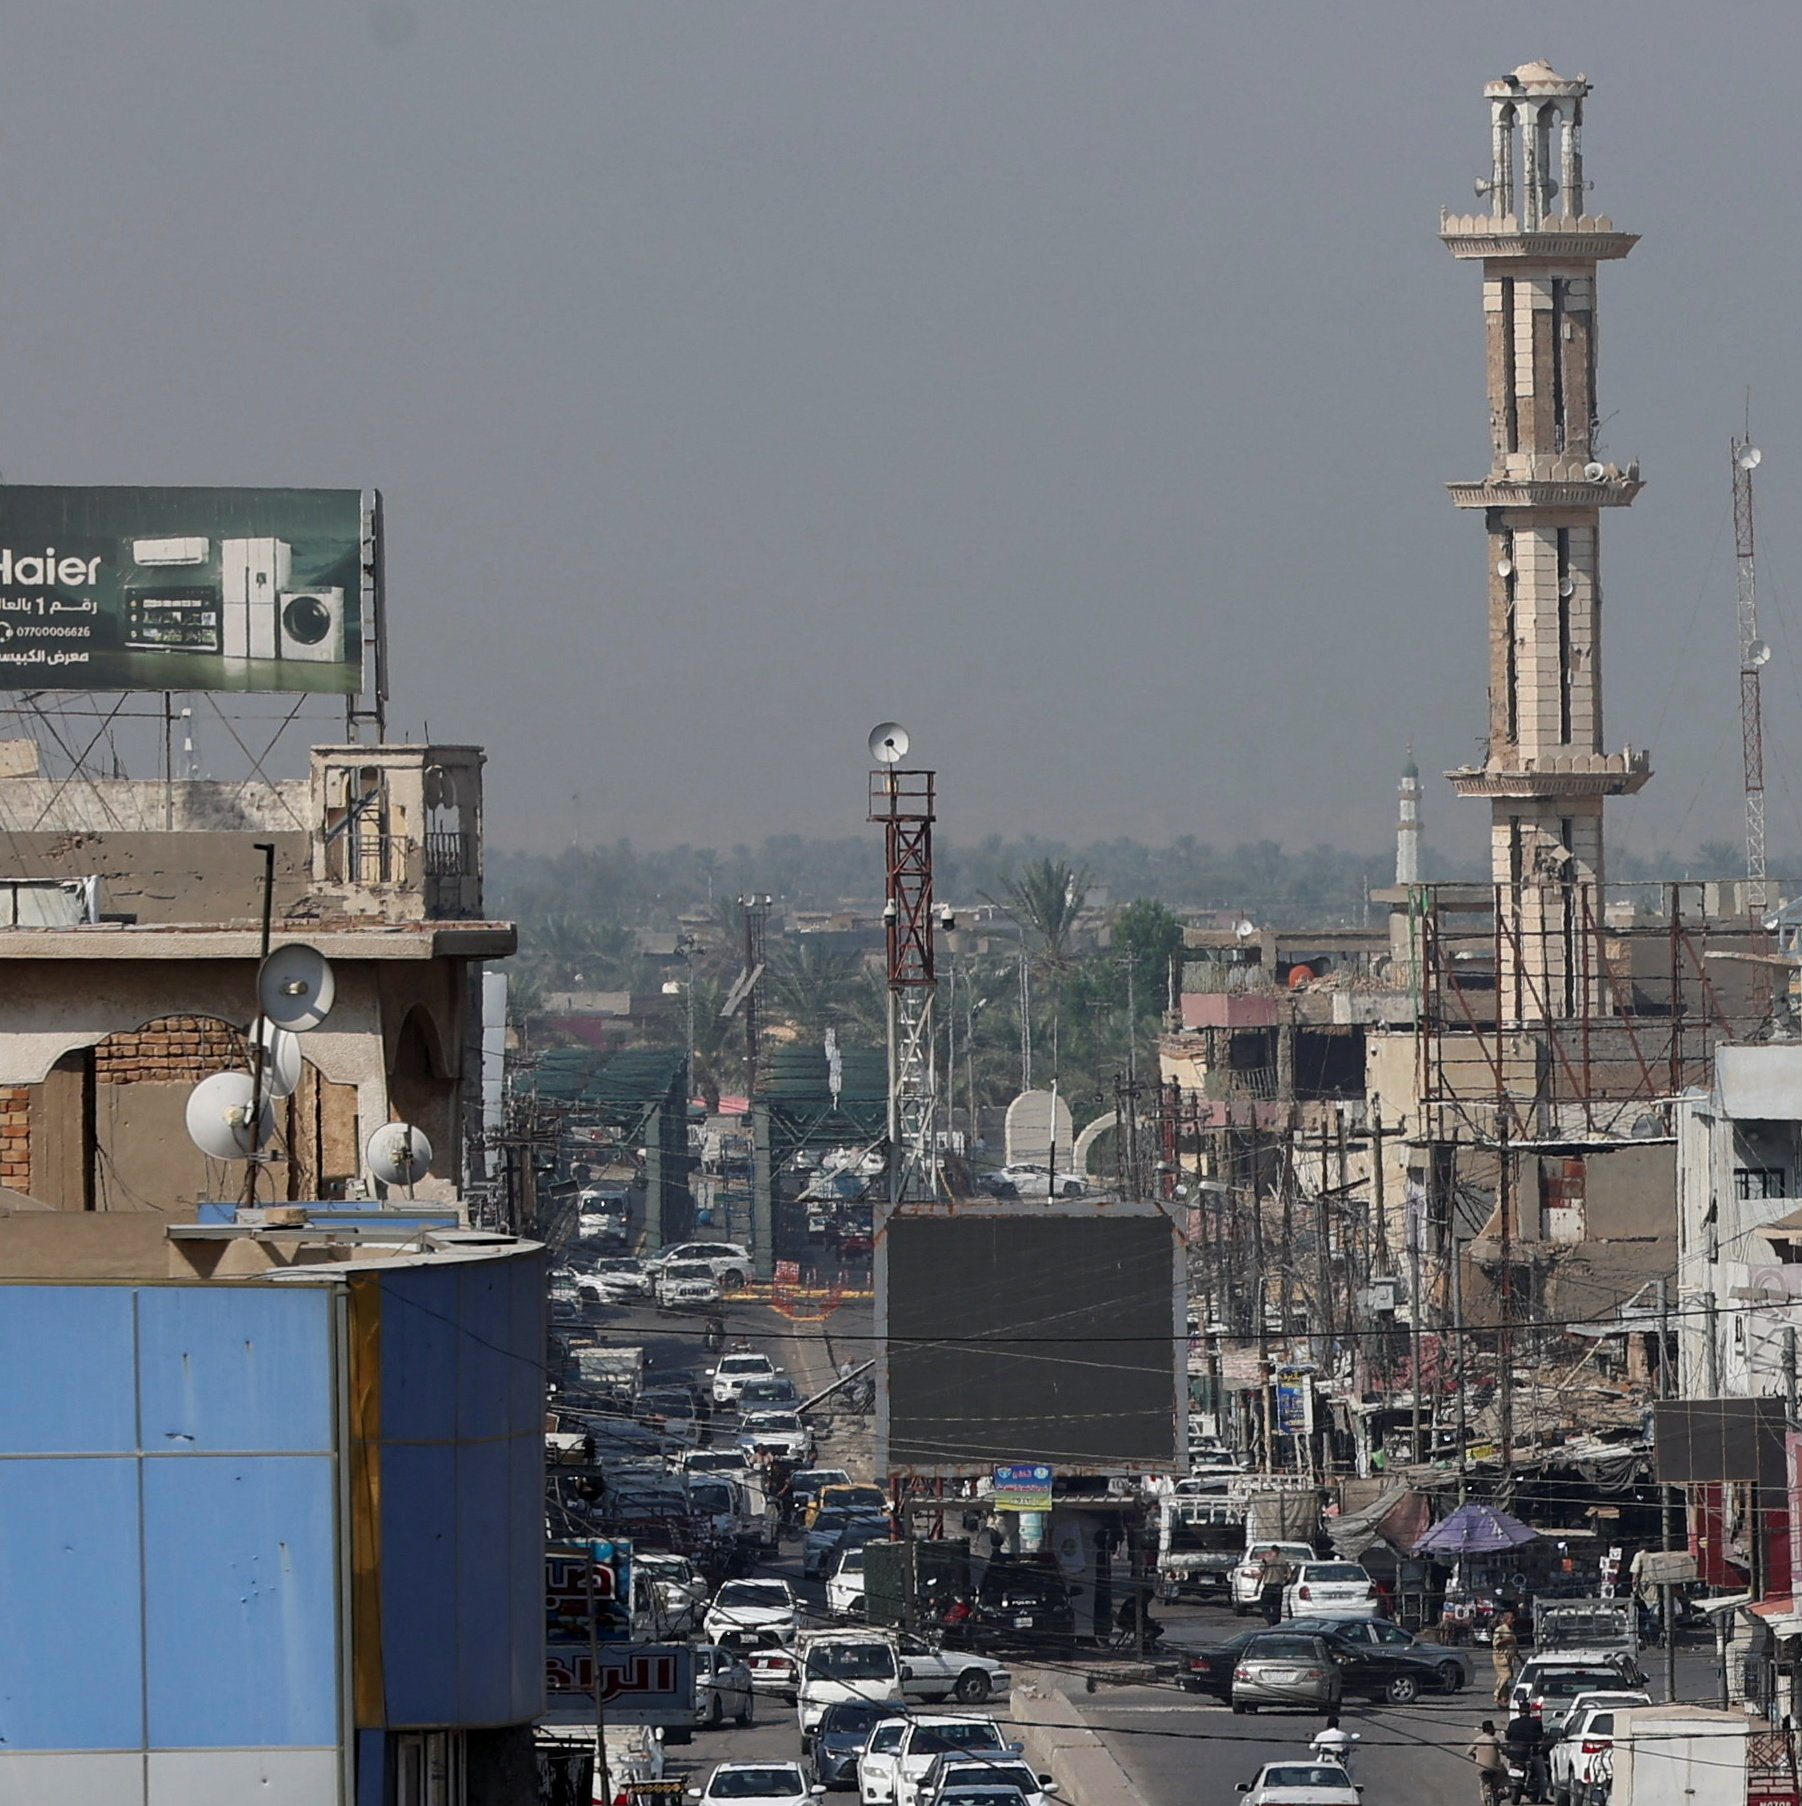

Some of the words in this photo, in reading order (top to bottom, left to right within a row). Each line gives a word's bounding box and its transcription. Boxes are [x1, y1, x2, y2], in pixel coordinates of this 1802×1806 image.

[0, 596, 32, 615] بالعا
[35, 596, 45, 615] 1
[49, 597, 98, 615] رقم
[47, 649, 90, 666] معرض
